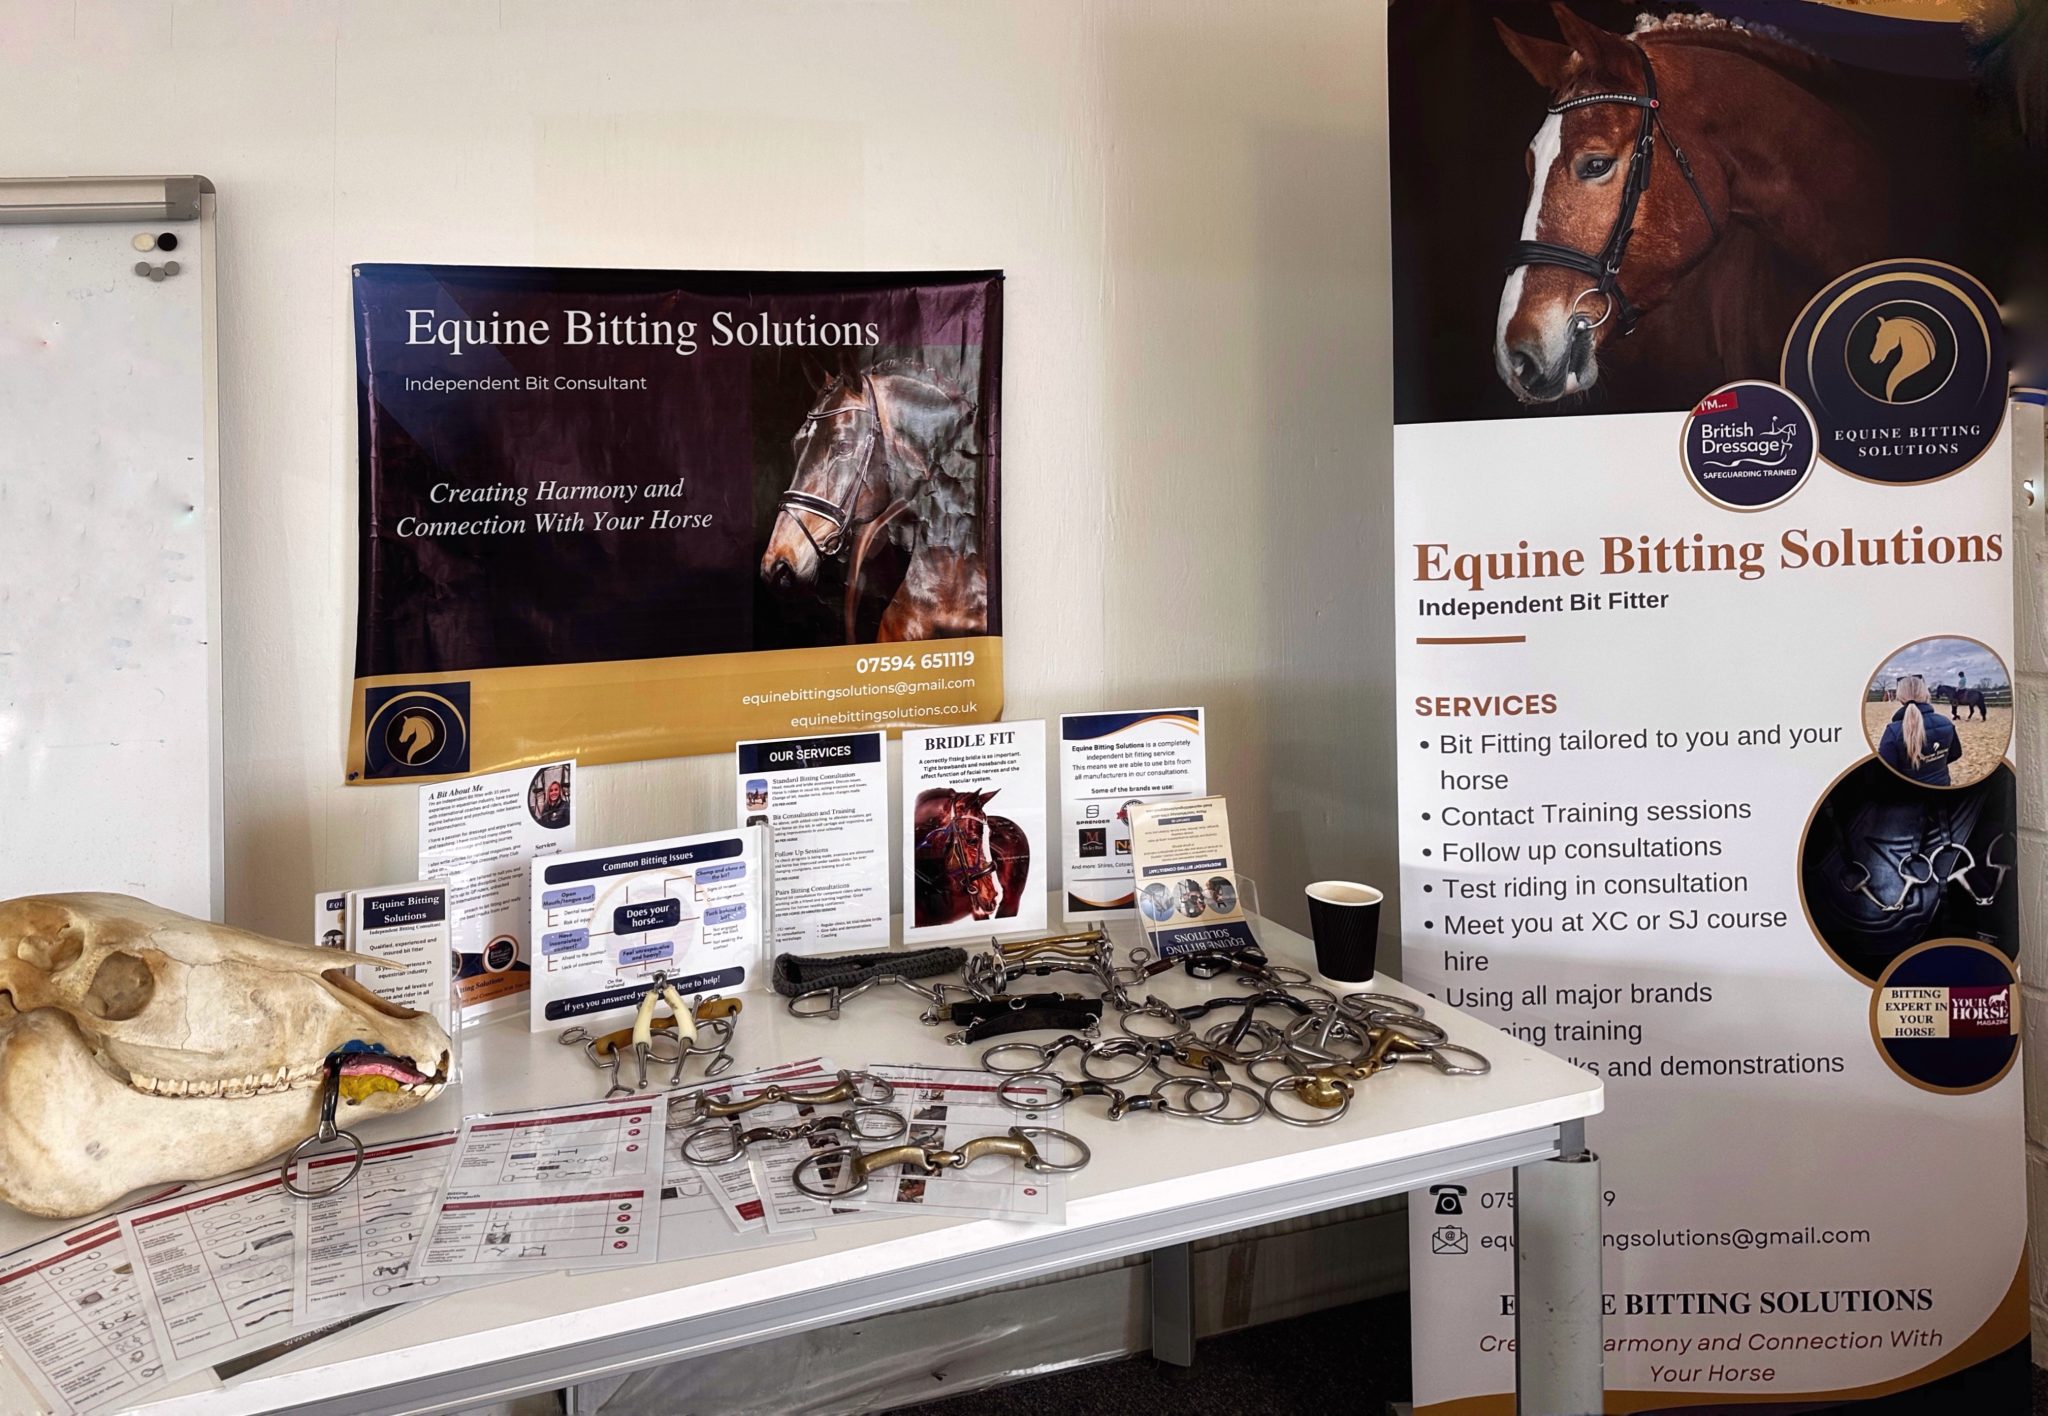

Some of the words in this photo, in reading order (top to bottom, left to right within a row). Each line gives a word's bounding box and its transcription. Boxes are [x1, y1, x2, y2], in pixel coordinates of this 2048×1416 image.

[405, 309, 550, 355] Equine
[563, 310, 698, 356] Bitting
[711, 311, 880, 347] Solutions
[405, 376, 520, 393] Independent
[526, 376, 549, 390] Bit
[554, 376, 647, 390] Consultant
[1701, 421, 1754, 438] British
[1834, 427, 1902, 441] EQUINE
[1909, 424, 1981, 438] BITTING
[1702, 440, 1780, 456] Dressage
[1858, 443, 1960, 457] SOLUTIONS
[1703, 470, 1761, 479] SAFEGUARDING
[430, 482, 528, 506] Creating
[536, 480, 638, 503] Harmony
[644, 478, 685, 498] and
[396, 515, 526, 537] Connection
[535, 512, 585, 533] With
[593, 511, 644, 531] Your
[649, 509, 713, 529] Horse
[1413, 540, 1585, 591] Equine
[1600, 533, 1765, 580] Bitting
[1780, 525, 2003, 570] Solutions
[1419, 595, 1563, 619] Independent
[1570, 592, 1601, 611] Bit
[1608, 591, 1669, 610] Fitter
[856, 655, 916, 673] 07594
[921, 651, 975, 669] 651119
[742, 677, 975, 706] equinebittingsolutions@gmail.com
[1415, 693, 1557, 717] SERVICES
[791, 701, 977, 728] equinebittingsolutions.co.uk
[925, 733, 985, 751] BRIDLE
[989, 731, 1016, 745] FIT
[1158, 740, 1191, 748] completely
[1440, 734, 1473, 754] Bit
[1481, 732, 1551, 756] Fitting
[1559, 728, 1647, 751] tailored
[1656, 729, 1678, 748] to
[1686, 730, 1729, 752] you
[1737, 724, 1781, 746] and
[1789, 726, 1843, 749] your
[769, 751, 793, 763] OUR
[796, 745, 852, 760] SERVICES
[1087, 753, 1124, 761] independent
[1134, 751, 1153, 759] fitting
[772, 777, 799, 785] Standard
[820, 771, 856, 780] Consultation
[1083, 772, 1127, 780] manufacturers
[1441, 770, 1509, 790] horse
[428, 793, 434, 801] A
[436, 789, 448, 799] Bit
[449, 787, 471, 797] About
[471, 784, 484, 793] Me
[782, 810, 819, 819] Consultation
[831, 807, 856, 815] Training
[1441, 806, 1534, 826] Contact
[1541, 801, 1639, 826] Training
[1647, 799, 1752, 821] sessions
[535, 841, 557, 850] Services
[774, 850, 794, 858] Follow
[794, 849, 804, 857] Up
[1443, 842, 1520, 863] Follow
[1528, 843, 1556, 865] up
[1564, 836, 1722, 859] consultations
[603, 860, 639, 871] Common
[641, 855, 668, 866] Bitting
[669, 851, 694, 861] Issues
[775, 888, 790, 896] Pairs
[811, 883, 850, 892] Consultations
[1442, 879, 1496, 899] Test
[1504, 876, 1567, 900] riding
[1576, 875, 1596, 895] in
[1604, 872, 1748, 895] consultation
[371, 898, 405, 912] Equine
[408, 894, 440, 906] Bitting
[626, 908, 648, 919] Does
[650, 904, 670, 916] your
[384, 912, 427, 924] Solutions
[632, 916, 664, 928] horse...
[1444, 915, 1504, 935] Meet
[1511, 917, 1553, 938] you
[1561, 913, 1584, 932] at
[1592, 911, 1629, 931] XC
[1636, 914, 1660, 930] or
[1669, 910, 1698, 930] SJ
[1707, 911, 1787, 929] course
[1174, 928, 1229, 943] SOLUTIONS
[1208, 937, 1246, 949] EQUINE
[1165, 941, 1207, 955] BITTING
[1444, 950, 1489, 972] hire
[677, 981, 693, 990] here
[703, 974, 721, 985] help!
[572, 1003, 584, 1012] yes
[586, 1001, 600, 1010] you
[601, 991, 636, 1005] answered
[1446, 987, 1513, 1011] Using
[1521, 985, 1547, 1006] all
[1556, 984, 1622, 1009] major
[1631, 981, 1713, 1004] brands
[1891, 990, 1941, 999] BITTING
[1952, 998, 1988, 1008] YOUR
[1885, 1002, 1932, 1011] EXPERT
[1935, 1002, 1948, 1011] IN
[1952, 1006, 2009, 1020] HORSE
[1899, 1015, 1934, 1024] YOUR
[1554, 1020, 1642, 1045] training
[1895, 1028, 1936, 1037] HORSE
[1608, 1056, 1652, 1077] and
[1660, 1053, 1845, 1076] demonstrations
[1625, 1292, 1752, 1315] BITTING
[1760, 1288, 1933, 1314] SOLUTIONS
[1603, 1337, 1692, 1355] armony
[1697, 1333, 1742, 1351] and
[1748, 1331, 1883, 1350] Connection
[1890, 1329, 1943, 1348] With
[1650, 1365, 1702, 1382] Your
[1709, 1364, 1775, 1381] Horse
